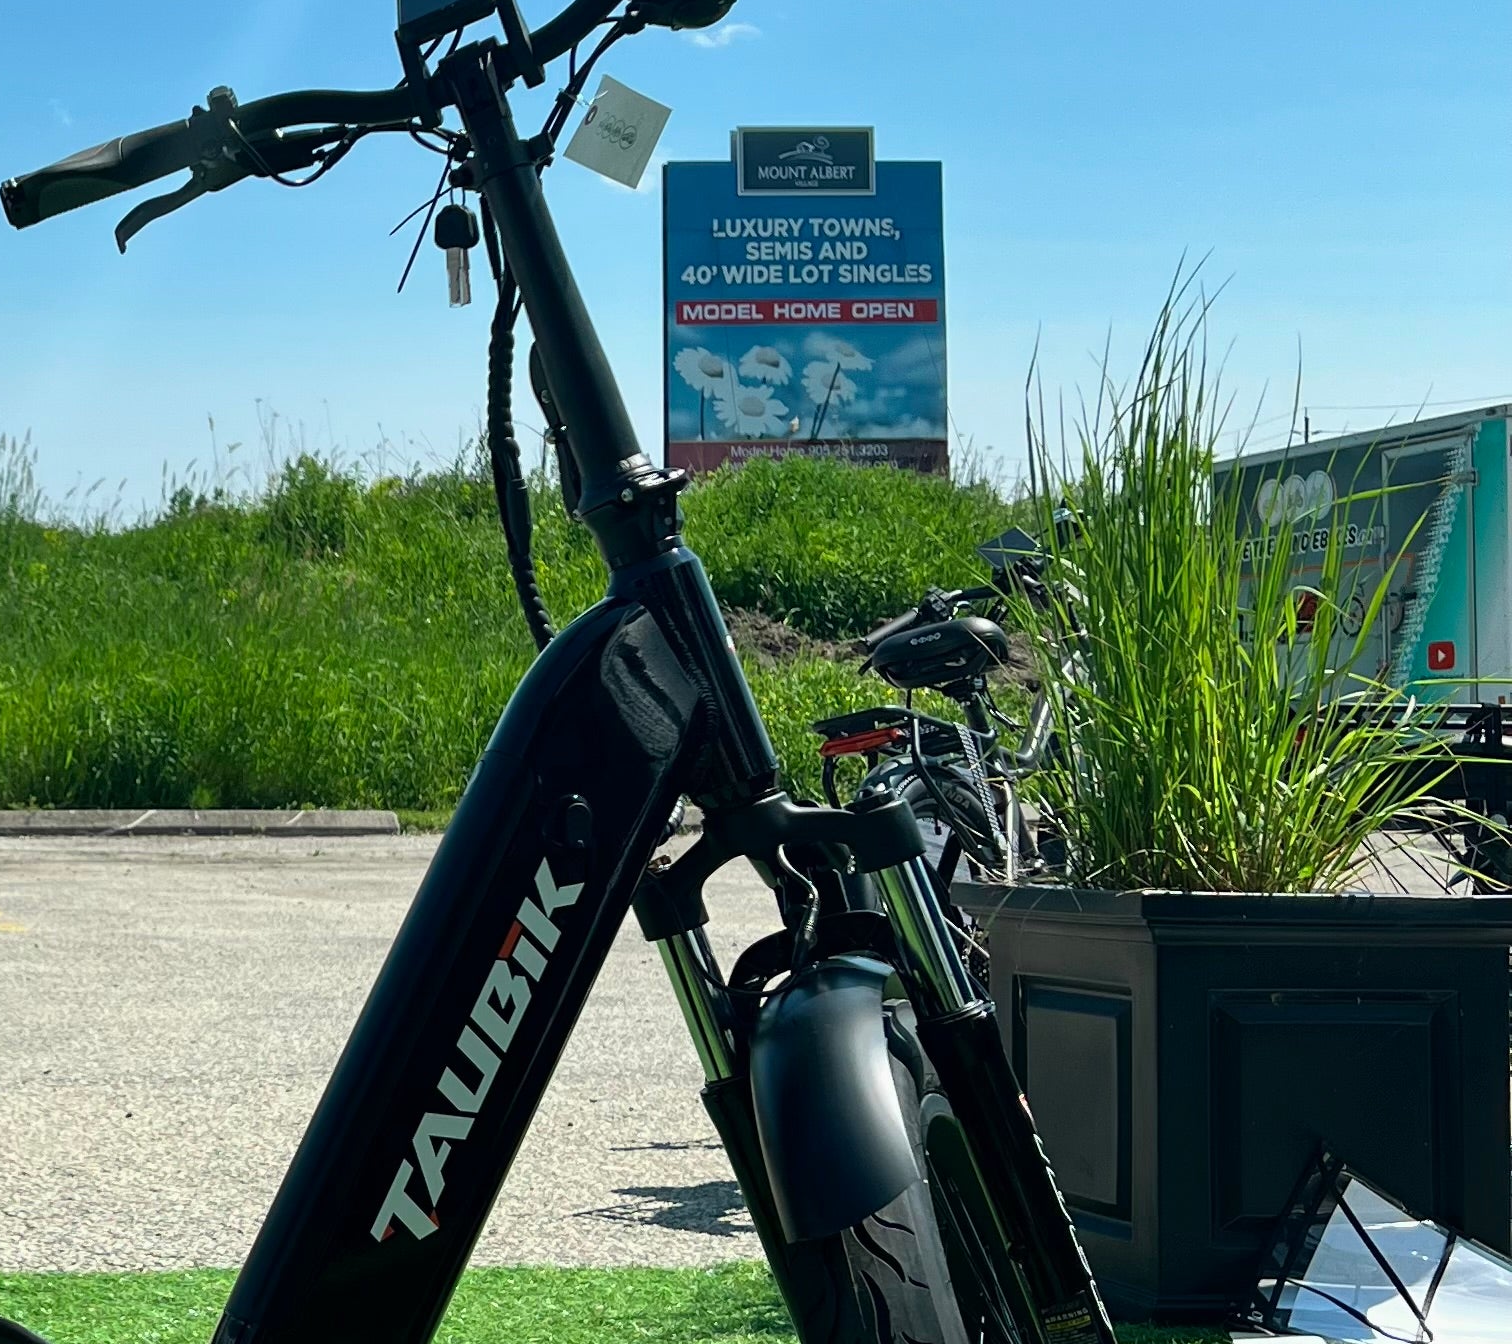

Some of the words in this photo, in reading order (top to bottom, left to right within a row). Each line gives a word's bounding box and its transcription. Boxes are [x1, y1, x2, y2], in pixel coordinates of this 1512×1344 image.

[757, 165, 807, 180] MOUNT
[809, 165, 856, 180] ALBERT
[712, 218, 801, 238] LUXURY
[808, 218, 900, 240] TOWNS,
[746, 241, 813, 261] SEMIS
[818, 241, 867, 261] AND
[721, 265, 783, 284] WIDE
[789, 265, 833, 284] LOT
[838, 264, 932, 284] SINGLES
[682, 304, 763, 321] MODEL
[774, 303, 841, 320] HOME
[851, 302, 914, 319] OPEN
